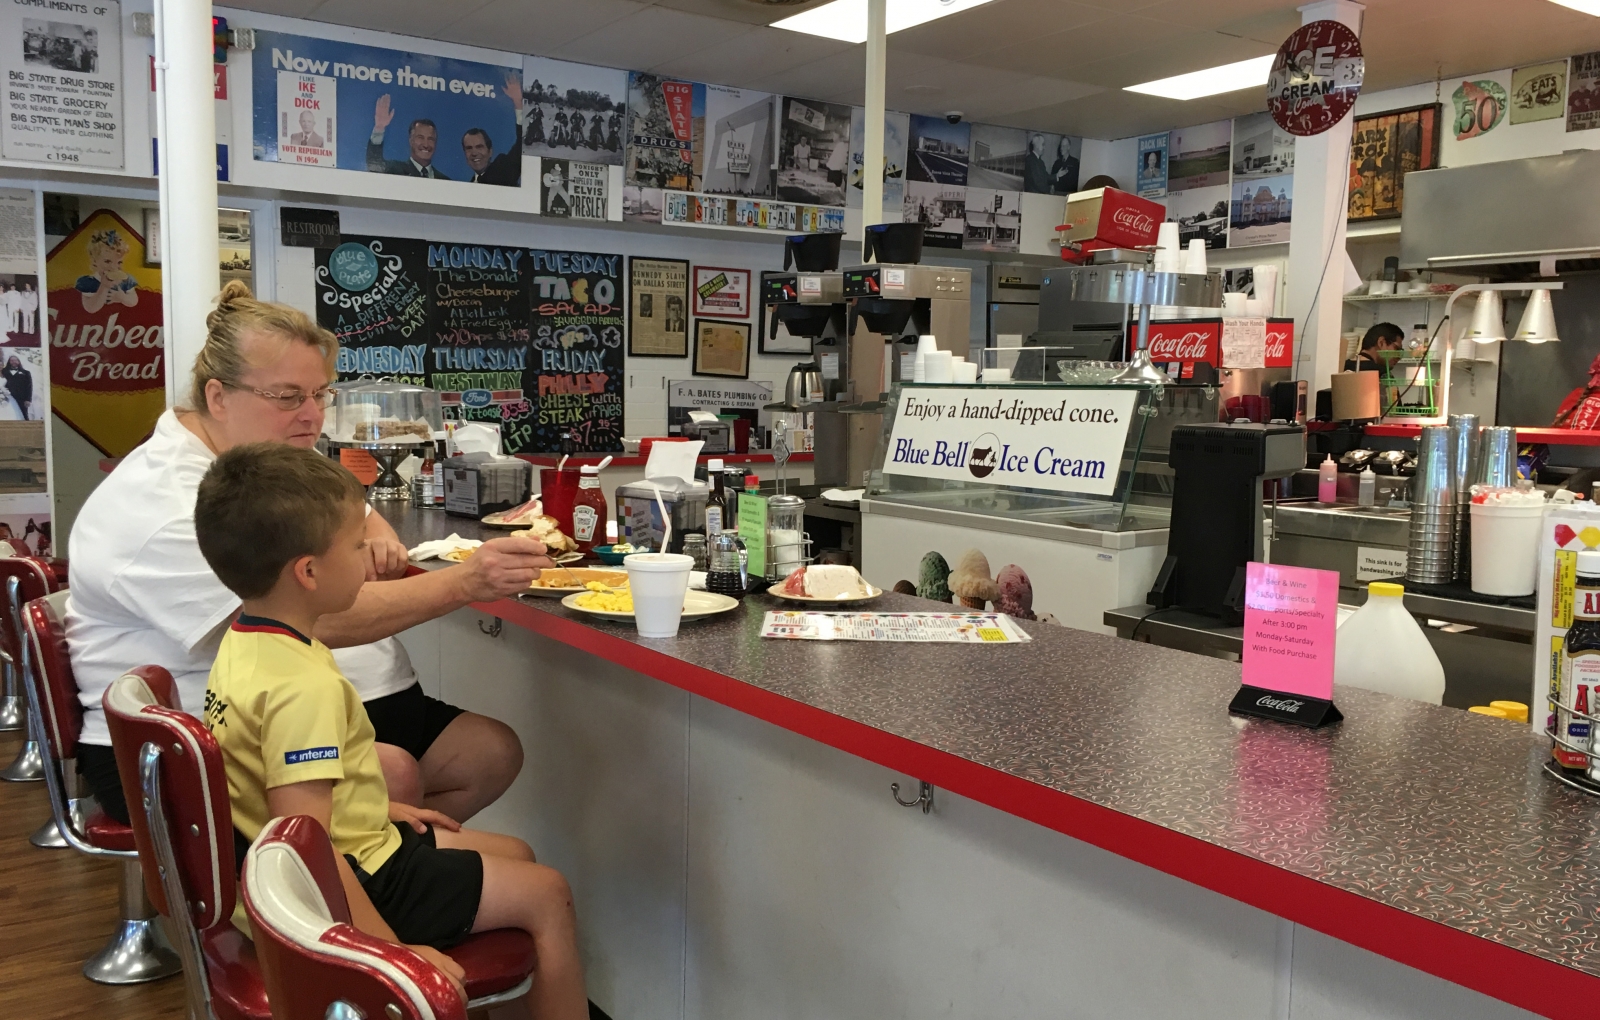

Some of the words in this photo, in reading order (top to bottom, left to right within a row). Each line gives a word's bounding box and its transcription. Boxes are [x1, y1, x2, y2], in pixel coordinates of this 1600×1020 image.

[93, 6, 108, 16] OF
[1289, 34, 1300, 51] 11
[1305, 26, 1322, 42] 12
[1328, 28, 1335, 45] 1
[1339, 41, 1352, 58] 2
[272, 48, 329, 75] Now
[334, 61, 393, 84] more
[396, 65, 446, 92] than
[449, 77, 497, 99] ever.
[1344, 63, 1355, 80] 3
[9, 70, 24, 81] BIG
[28, 73, 56, 84] STATE
[60, 76, 84, 87] DRUG
[87, 80, 115, 92] STORE
[298, 81, 316, 93] IKE
[667, 85, 689, 94] BIG
[1531, 76, 1557, 93] EATS
[55, 86, 78, 94] MODERN
[82, 89, 112, 98] FOUNTAIN
[1281, 80, 1335, 101] CREAM
[9, 91, 25, 101] BIG
[29, 93, 58, 105] STATE
[62, 97, 108, 110] GROCERY
[294, 98, 320, 110] DICK
[1273, 97, 1282, 113] 8
[10, 102, 27, 111] YOUR
[57, 107, 81, 115] GARDEN
[95, 110, 113, 119] EDEN
[672, 96, 688, 138] STATE
[1285, 111, 1293, 127] 7
[1320, 105, 1333, 122] 5
[11, 113, 27, 122] BIG
[30, 115, 60, 126] STATE
[64, 118, 90, 129] MAN'S
[93, 121, 116, 132] SHOP
[1300, 114, 1312, 130] 6
[11, 123, 46, 133] QUALITY
[52, 127, 75, 136] MEN'S
[78, 130, 114, 140] CLOTHING
[282, 145, 297, 154] VOTE
[298, 146, 333, 157] REPUBLICAN
[641, 137, 687, 149] DRUGS
[1140, 138, 1156, 151] BACK
[1156, 136, 1167, 147] IKE
[56, 152, 79, 163] 1948
[304, 156, 319, 164] 1956
[574, 163, 603, 172] TONIGHT
[579, 170, 600, 178] ONLY
[574, 185, 603, 196] ELVIS
[569, 194, 607, 219] PRESLEY
[668, 202, 687, 216] BIG
[695, 204, 728, 222] STATE
[286, 221, 339, 236] RESTROOMS
[1113, 208, 1154, 234] Coca-Cola
[335, 251, 366, 264] Blue
[427, 244, 523, 273] MONDAY
[529, 250, 619, 278] TUESDAY
[338, 269, 372, 285] Plate
[632, 270, 662, 279] KENNEDY
[666, 272, 686, 280] SLAIN
[339, 265, 398, 313] Special
[435, 283, 521, 302] Cheeseburger
[533, 276, 616, 306] TACO
[643, 279, 665, 288] DALLAS
[667, 281, 686, 289] STREET
[357, 271, 412, 322] DIFFERENT
[394, 281, 421, 312] EVERY
[338, 313, 346, 325] A
[480, 306, 509, 317] Link
[460, 319, 488, 328] Fried
[1147, 332, 1212, 358] Coca-Cola
[69, 351, 162, 381] Bread
[335, 343, 427, 375] EDNESDAY
[431, 346, 528, 371] THURSDAY
[542, 348, 607, 374] FRIDAY
[431, 371, 523, 392] WESTWAY
[538, 373, 610, 396] PHILLY
[466, 391, 489, 403] Ford
[538, 393, 591, 409] CHEESE
[678, 388, 686, 397] F.
[687, 388, 696, 397] A.
[697, 389, 721, 399] BATES
[724, 391, 757, 401] PLUMBING
[692, 398, 731, 406] CONTRACTING
[538, 408, 584, 425] STEAK
[904, 397, 946, 422] Enjoy
[948, 405, 956, 418] a
[960, 398, 1067, 425] hand-dipped
[1069, 407, 1119, 424] cone.
[504, 424, 532, 454] LTP
[892, 438, 930, 464] Blue
[931, 440, 969, 468] Bell
[998, 444, 1029, 473] Ice
[1033, 446, 1106, 479] Cream
[1360, 566, 1394, 576] handwashing
[1265, 578, 1281, 586] Beer
[1290, 580, 1308, 589] Wine
[1275, 593, 1309, 603] Domestics
[1262, 618, 1279, 627] After
[1280, 620, 1295, 629] 3:00
[1296, 623, 1308, 631] pm
[1255, 631, 1315, 647] Monday-Saturday
[1252, 644, 1268, 652] With
[1269, 646, 1286, 656] Food
[1287, 649, 1318, 660] Purchase
[1256, 695, 1305, 713] Coca-Cola
